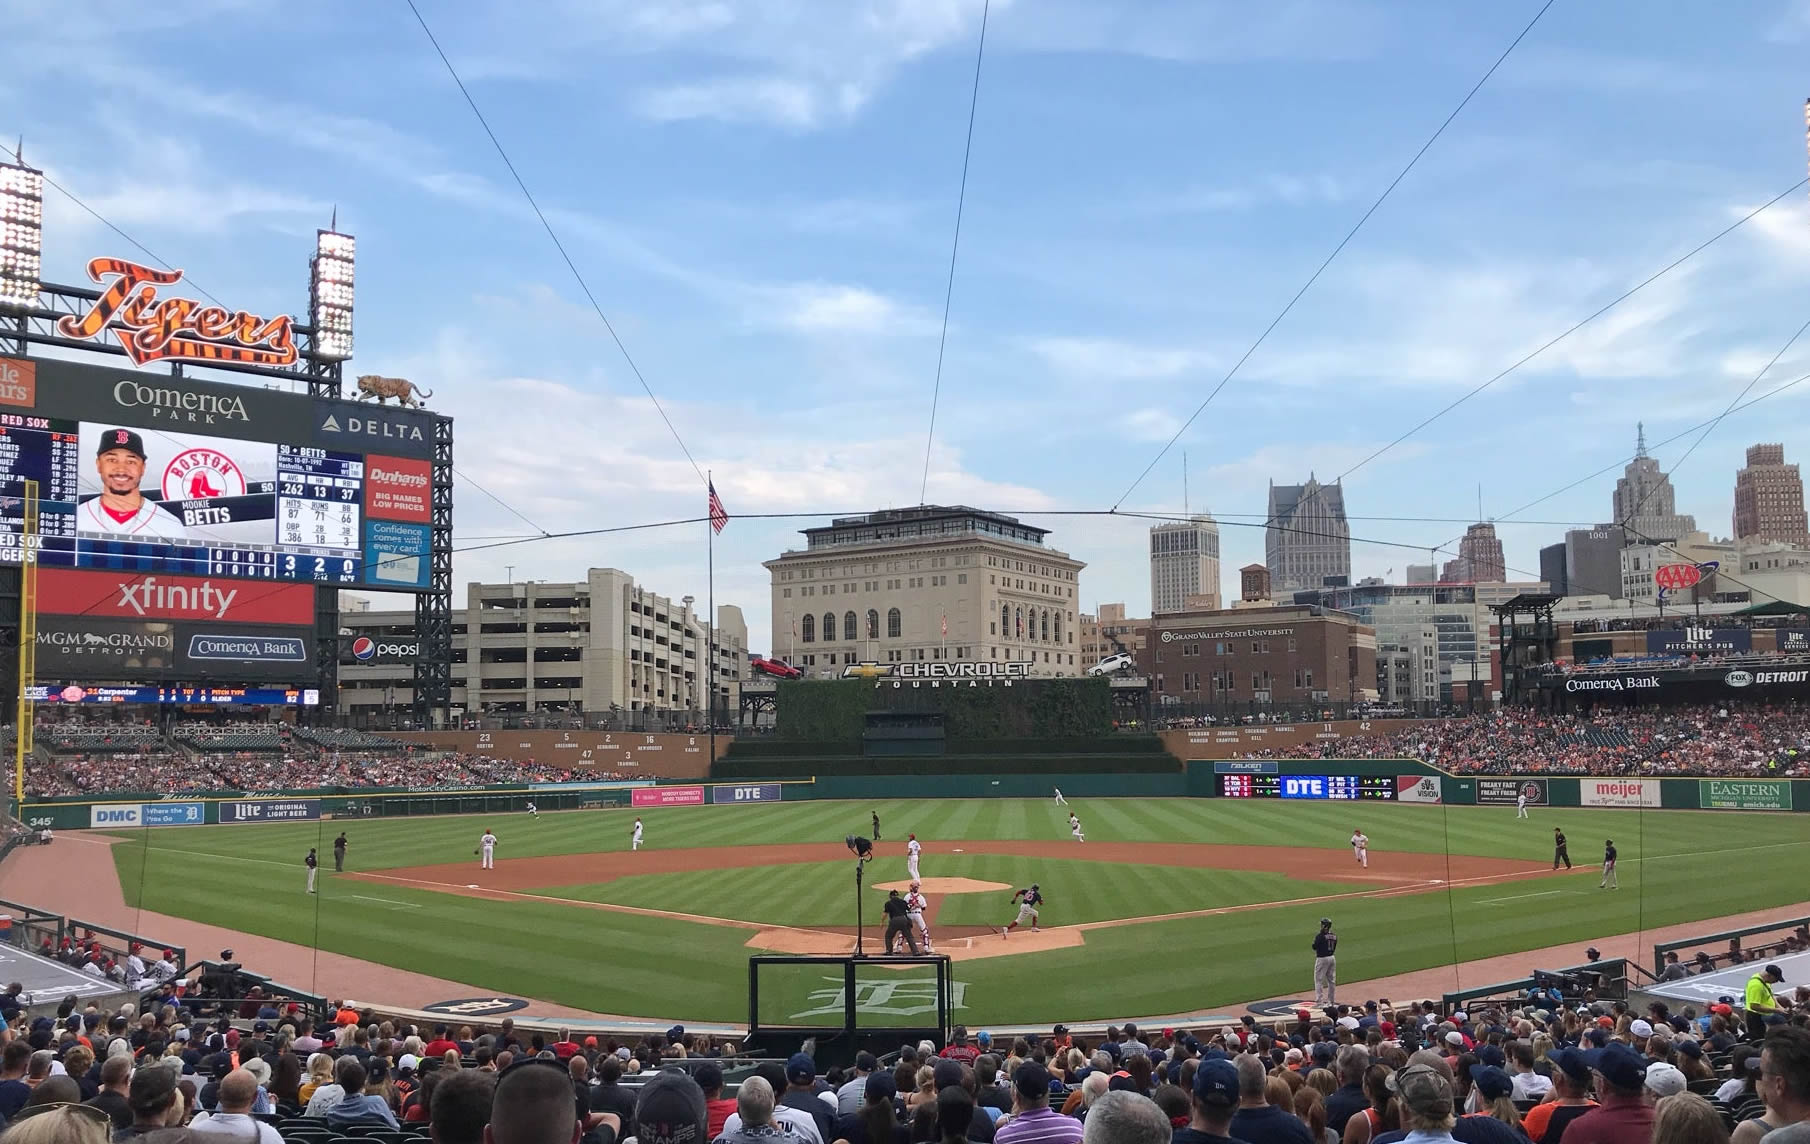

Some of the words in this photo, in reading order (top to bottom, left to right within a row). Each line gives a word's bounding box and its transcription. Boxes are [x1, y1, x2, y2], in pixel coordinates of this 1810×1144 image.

[57, 256, 299, 368] Tigers
[1, 414, 23, 425] RED
[27, 417, 49, 429] SOX
[153, 408, 216, 425] PARK
[348, 418, 424, 442] DELTA
[280, 444, 290, 454] 50
[300, 447, 326, 458] BETTS
[170, 452, 233, 478] BOSTON
[371, 468, 428, 486] Dunham's
[261, 482, 274, 492] 50
[281, 484, 303, 496] .262
[314, 486, 326, 497] 13
[342, 489, 354, 500] 37
[286, 500, 301, 508] HITS
[376, 492, 390, 500] BIG
[392, 494, 422, 504] NAMES
[182, 500, 210, 510] MOOKIE
[373, 500, 392, 508] LOW
[394, 502, 425, 512] PRICES
[184, 507, 231, 526] BETTS
[288, 510, 299, 518] 87
[315, 512, 325, 520] 71
[342, 515, 352, 524] 66
[373, 524, 423, 536] Confidence
[1589, 532, 1608, 540] 1001
[19, 536, 44, 548] SOX
[284, 533, 302, 542] .386
[316, 535, 326, 544] 18
[344, 538, 350, 546] 3
[374, 534, 402, 543] comes
[404, 536, 423, 545] with
[374, 544, 397, 553] every
[216, 550, 222, 560] 0
[232, 551, 238, 562] 0
[248, 552, 254, 562] 0
[264, 554, 270, 564] 0
[285, 556, 296, 570] 3
[314, 558, 325, 572] 2
[343, 560, 354, 574] 0
[216, 563, 222, 574] 0
[232, 564, 238, 575] 0
[248, 565, 254, 576] 0
[264, 566, 270, 577] 0
[1660, 566, 1698, 588] AAA
[117, 577, 238, 618] xfinity
[36, 631, 80, 646] MGM
[108, 633, 169, 648] GRAND
[1172, 632, 1198, 640] GRAND
[1225, 630, 1247, 638] STATE
[1248, 629, 1294, 637] UNIVERSITY
[1686, 627, 1714, 644] Lite
[1788, 632, 1804, 642] Lite
[62, 647, 144, 656] DETROIT
[264, 643, 296, 654] Bank
[377, 643, 420, 658] pepsi
[899, 662, 1032, 677] CHEVROLET
[1626, 676, 1660, 688] Bank
[1731, 674, 1746, 682] FOX
[1756, 671, 1808, 684] DETROIT
[875, 680, 1013, 688] FOUNTAIN
[98, 688, 137, 696] Carpenter
[1324, 724, 1332, 732] 11
[1360, 722, 1371, 730] 42
[480, 734, 490, 742] 23
[646, 736, 654, 744] 16
[690, 737, 695, 745] 6
[582, 750, 592, 758] 47
[1286, 780, 1322, 794] DTE
[1596, 781, 1643, 798] meijer
[1710, 782, 1780, 796] EASTERN
[734, 788, 760, 800] DTE
[96, 810, 136, 822] DMC
[146, 807, 169, 815] Where
[234, 804, 261, 820] Lite
